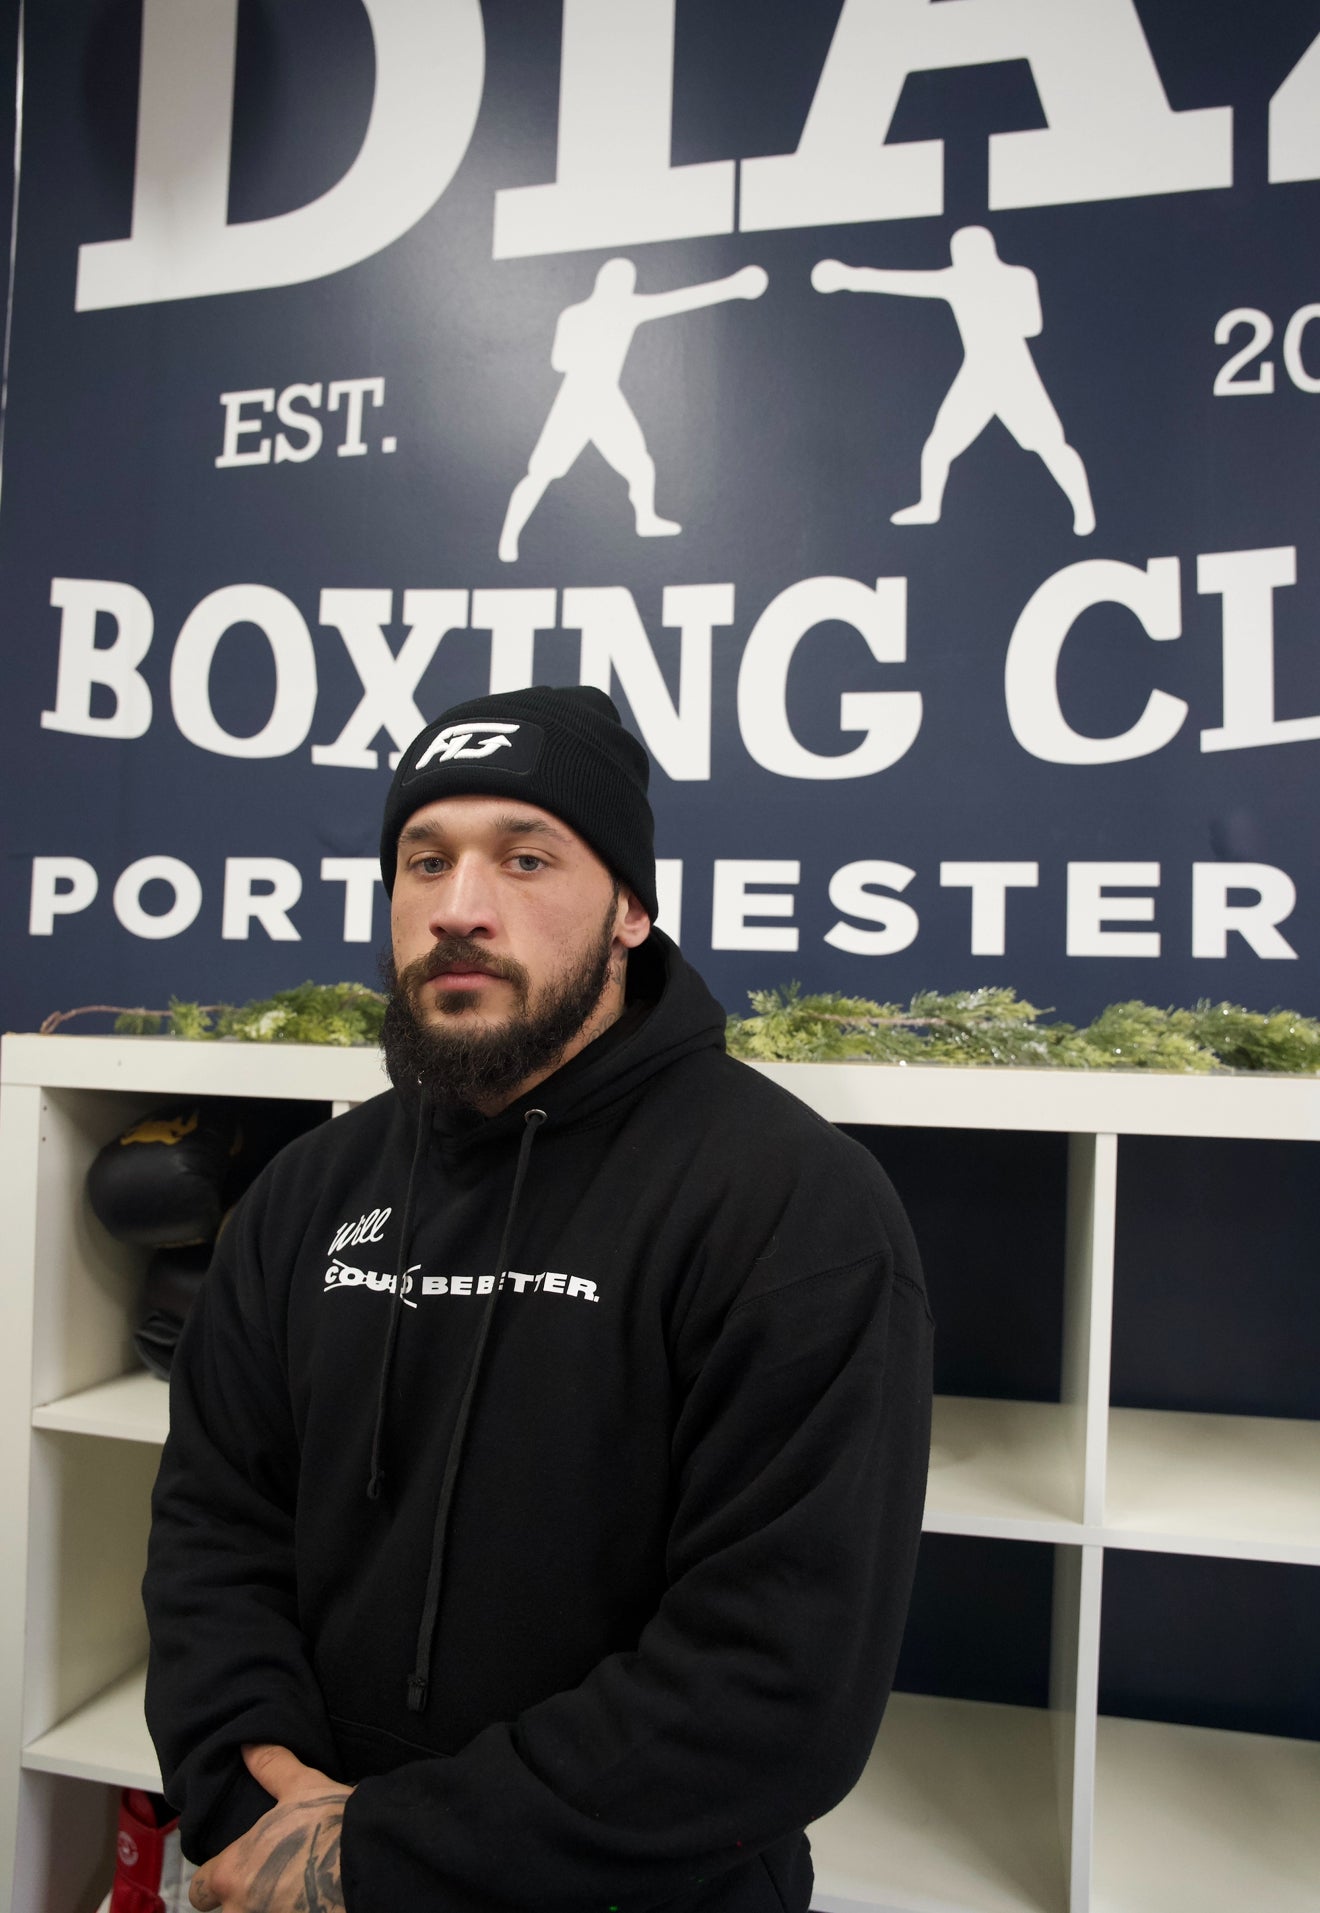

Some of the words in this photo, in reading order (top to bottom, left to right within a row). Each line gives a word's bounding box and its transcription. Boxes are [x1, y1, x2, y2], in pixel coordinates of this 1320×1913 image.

[75, 0, 1320, 312] DIA
[215, 377, 397, 468] EST.
[41, 576, 923, 782] BOXING
[1004, 545, 1320, 766] CL
[654, 858, 1298, 960] ESTER
[327, 1207, 393, 1257] Will
[475, 1270, 600, 1304] BTER.
